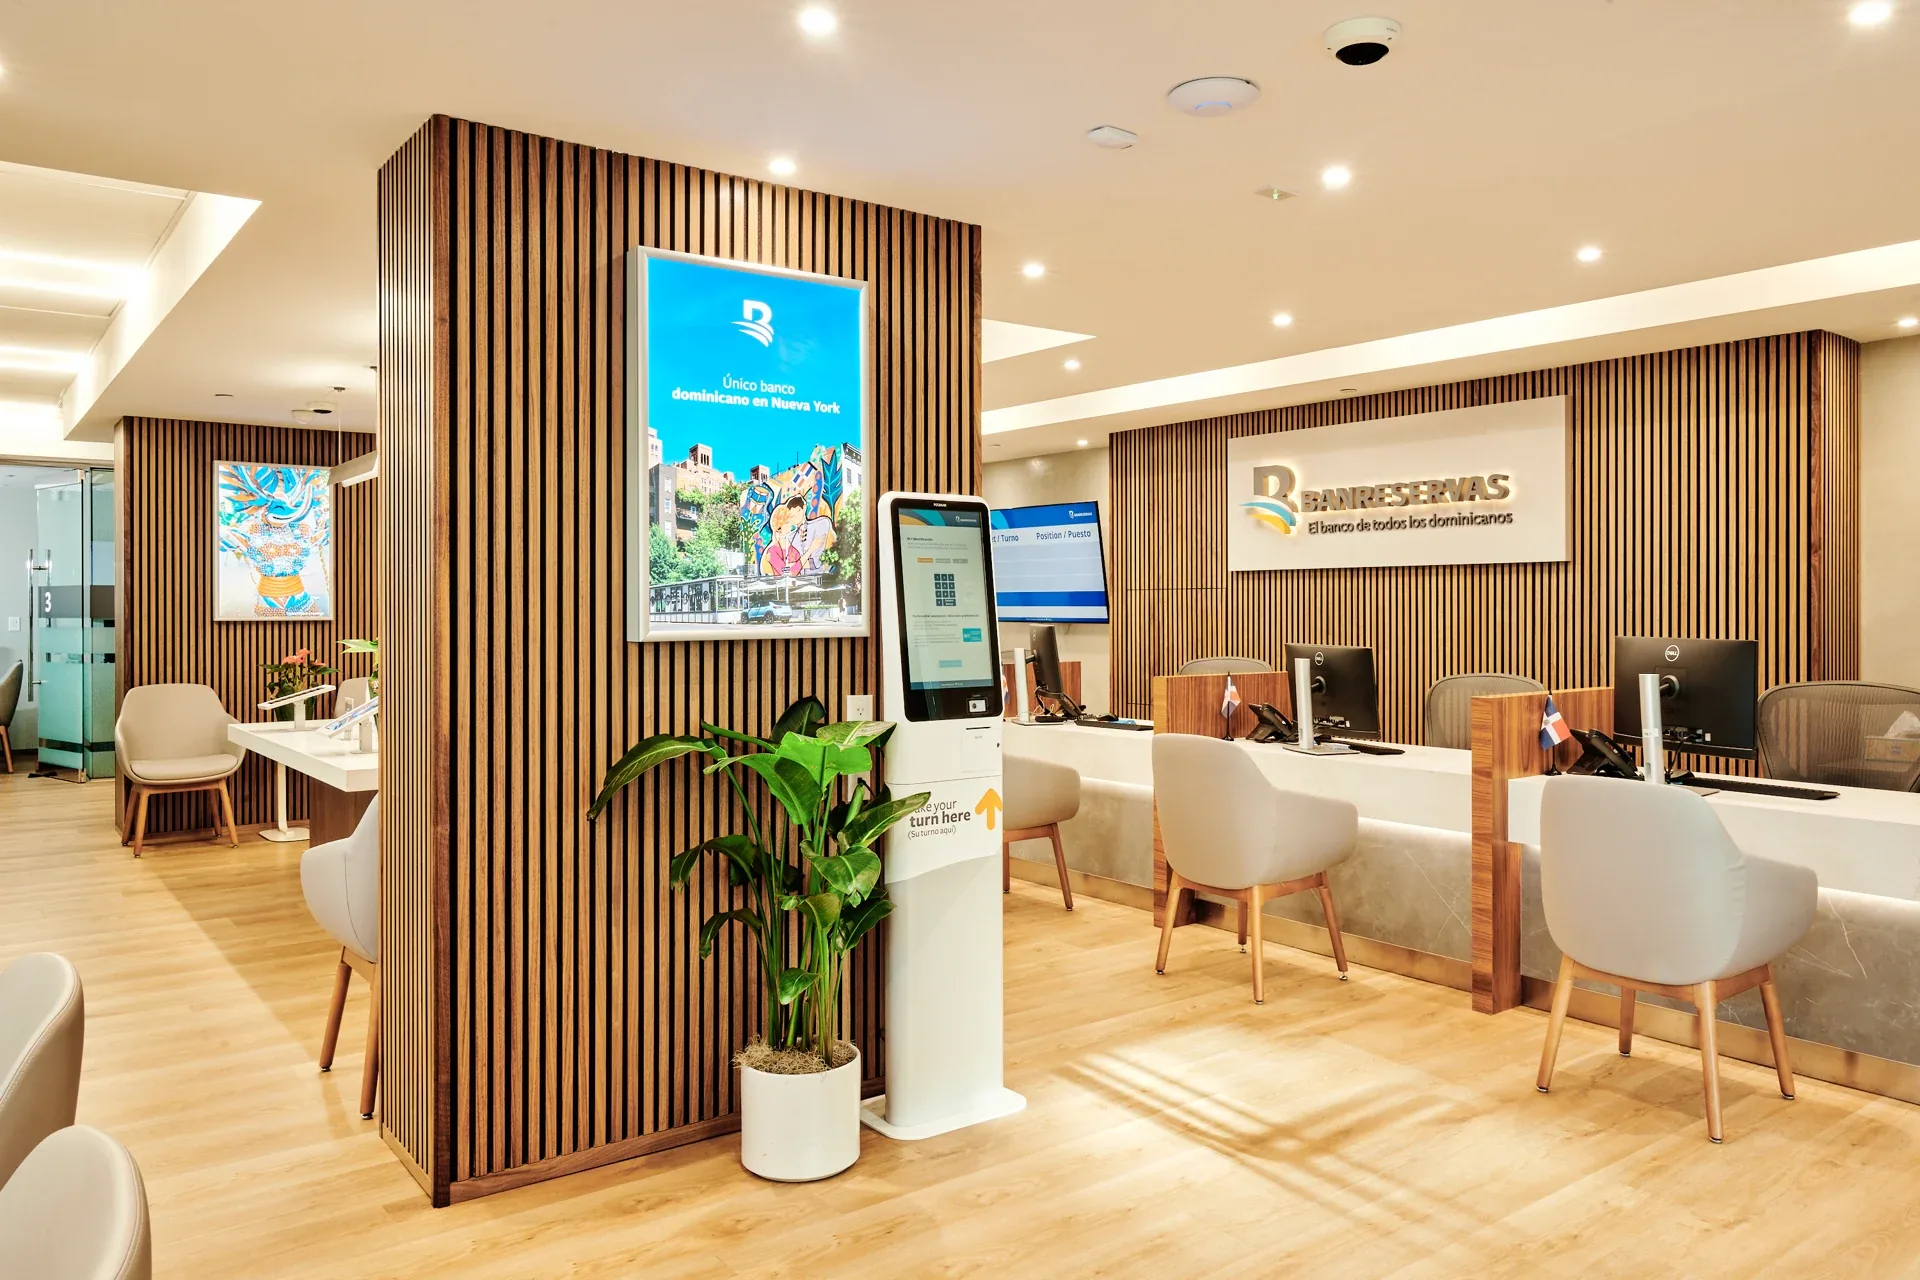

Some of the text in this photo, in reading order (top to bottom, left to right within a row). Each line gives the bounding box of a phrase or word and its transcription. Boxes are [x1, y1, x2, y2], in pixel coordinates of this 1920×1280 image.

[723, 373, 796, 395] Único banco
[671, 387, 841, 415] dominicano en Nueva York
[1300, 473, 1511, 513] BANRESERVAS
[1308, 512, 1513, 535] El banco de todos los dominicanos
[1001, 534, 1020, 542] Turno
[1036, 531, 1063, 540] Position
[1068, 529, 1092, 539] Puesto
[44, 591, 52, 613] 3
[933, 800, 957, 815] your
[909, 810, 971, 828] turn here
[907, 830, 920, 840] (Su
[920, 828, 939, 837] turno
